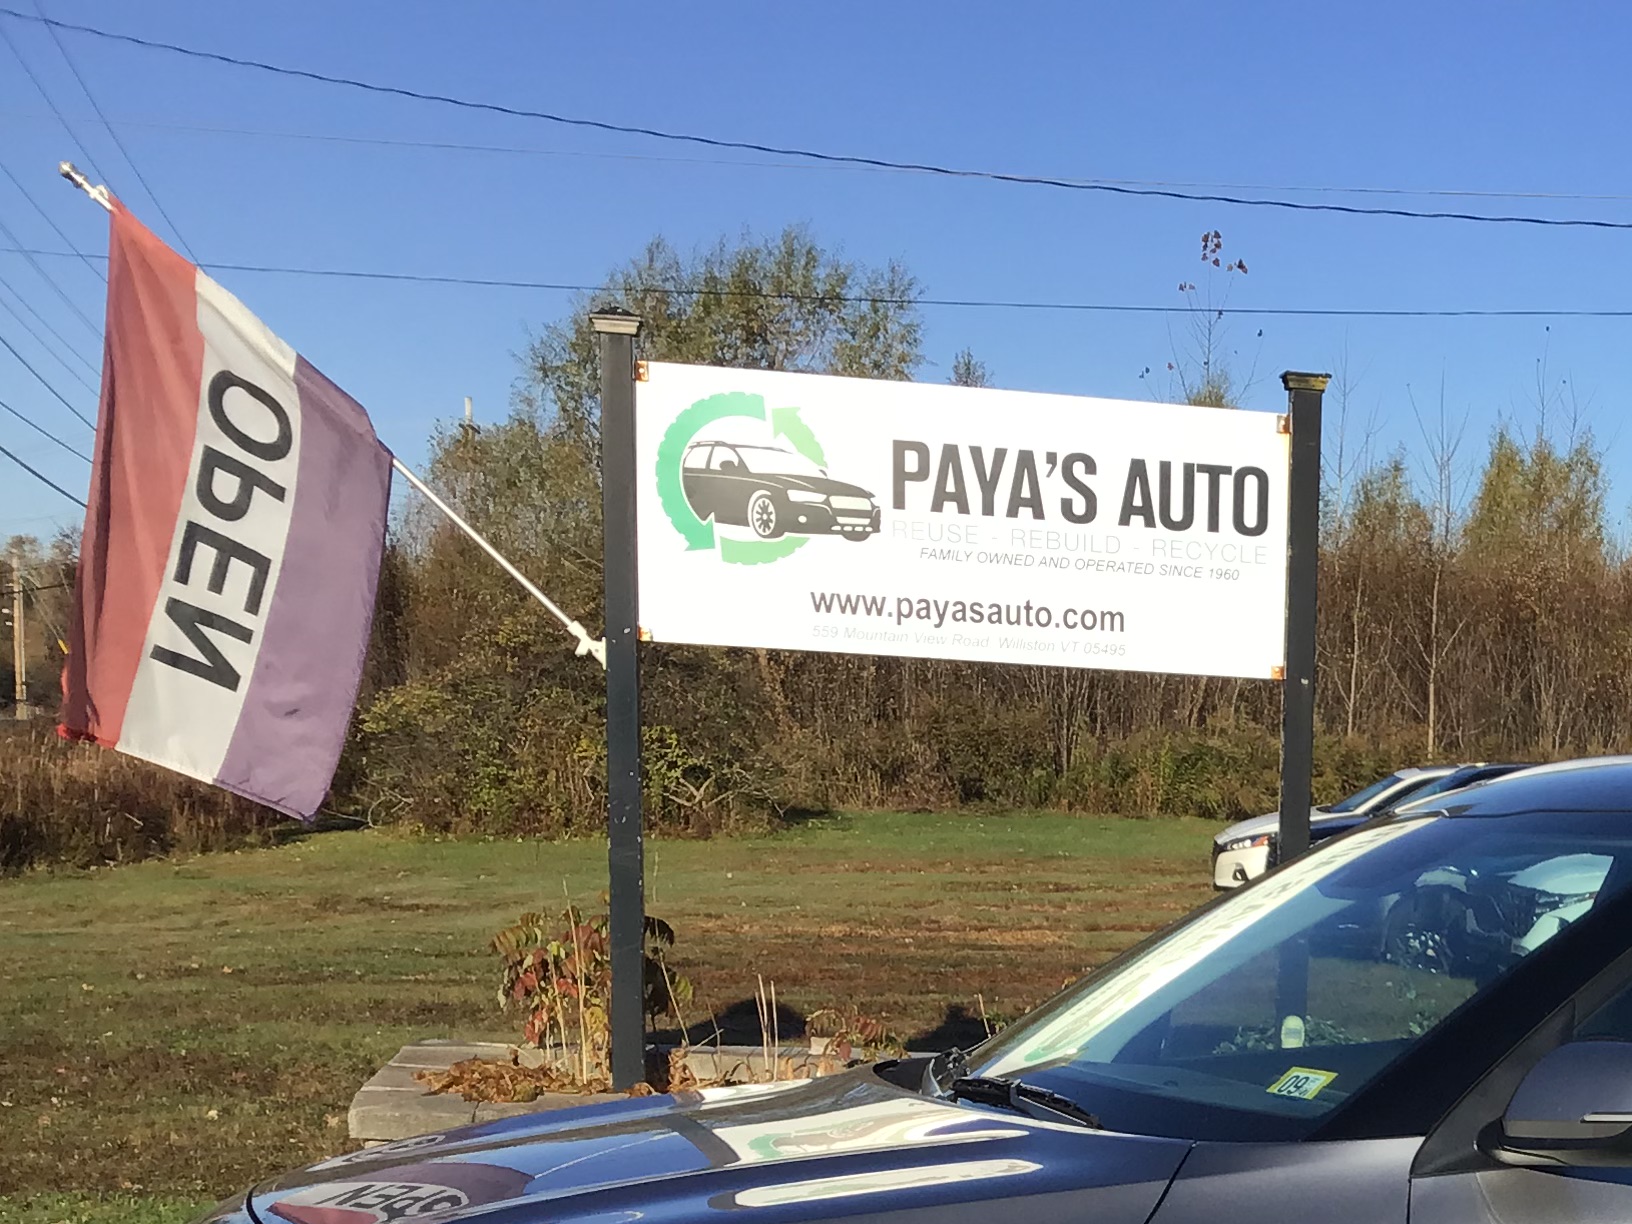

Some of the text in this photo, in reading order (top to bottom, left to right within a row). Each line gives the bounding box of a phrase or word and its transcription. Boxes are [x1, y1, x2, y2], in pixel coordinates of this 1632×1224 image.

[893, 438, 1269, 537] PAYA'S AUTO
[892, 519, 979, 545] REUSE
[1010, 527, 1121, 555] REBUILD
[1152, 538, 1268, 566] RECYCLE
[920, 547, 1240, 581] FAMILY OWNED AND OPERATED SINCE 1960
[810, 591, 1125, 632] www.payasauto.com
[812, 625, 839, 639] 559
[844, 627, 909, 643] Mountain
[914, 632, 948, 646] View
[999, 637, 1056, 652] Williston
[1060, 641, 1081, 653] VT
[1084, 641, 1126, 657] 05495
[1277, 1074, 1310, 1095] 09
